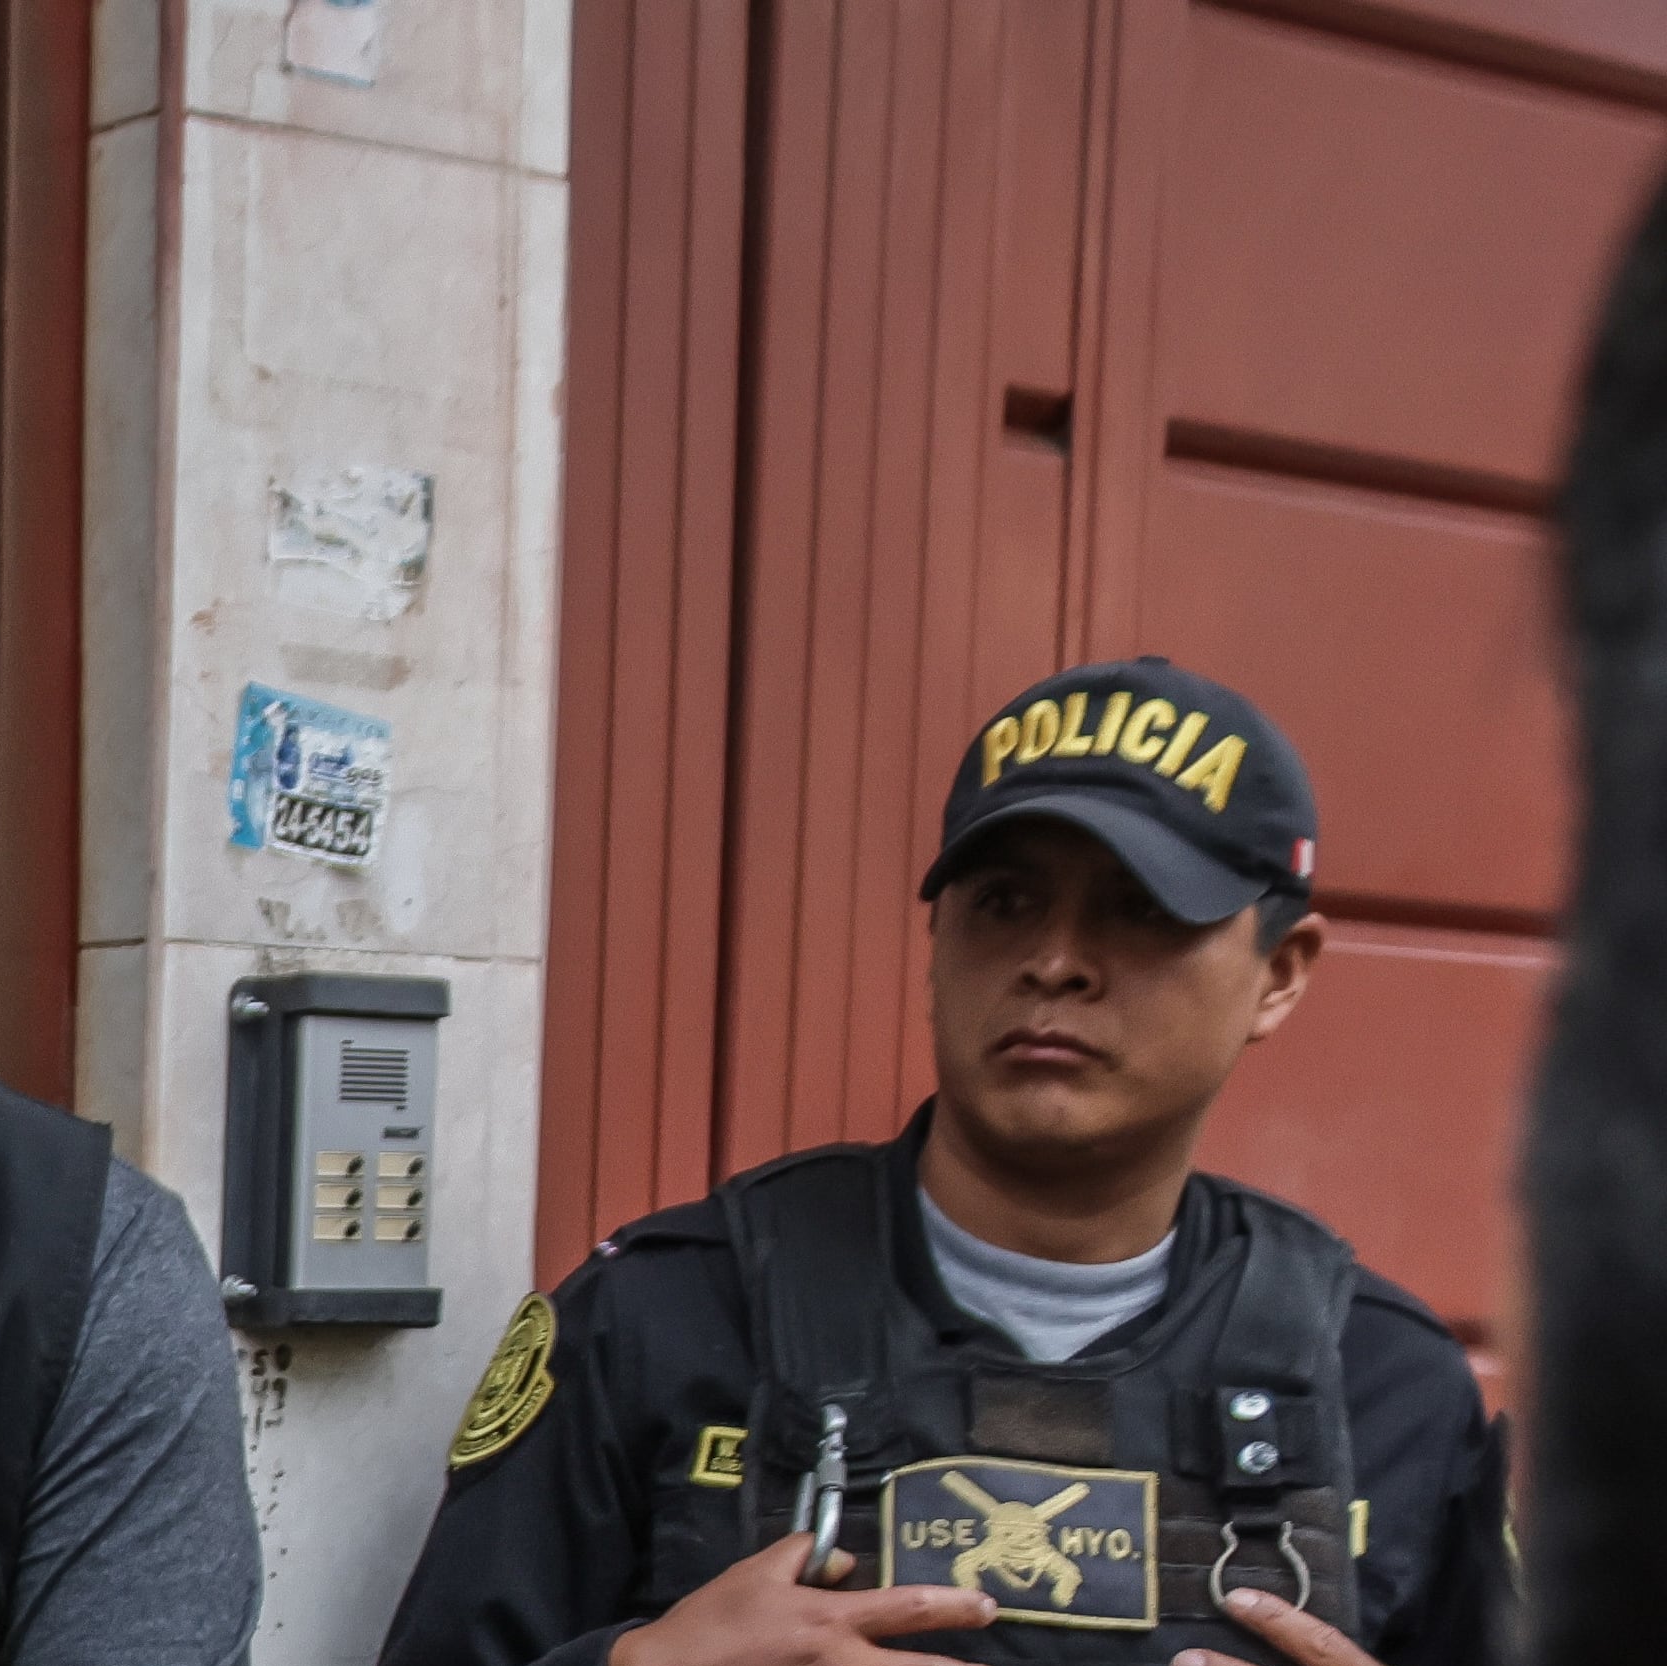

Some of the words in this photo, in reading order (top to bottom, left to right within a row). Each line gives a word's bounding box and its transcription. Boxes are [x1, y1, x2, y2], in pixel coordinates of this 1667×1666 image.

[981, 691, 1248, 815] POLICIA
[900, 1518, 978, 1549] USE
[1057, 1526, 1142, 1561] HYO.
